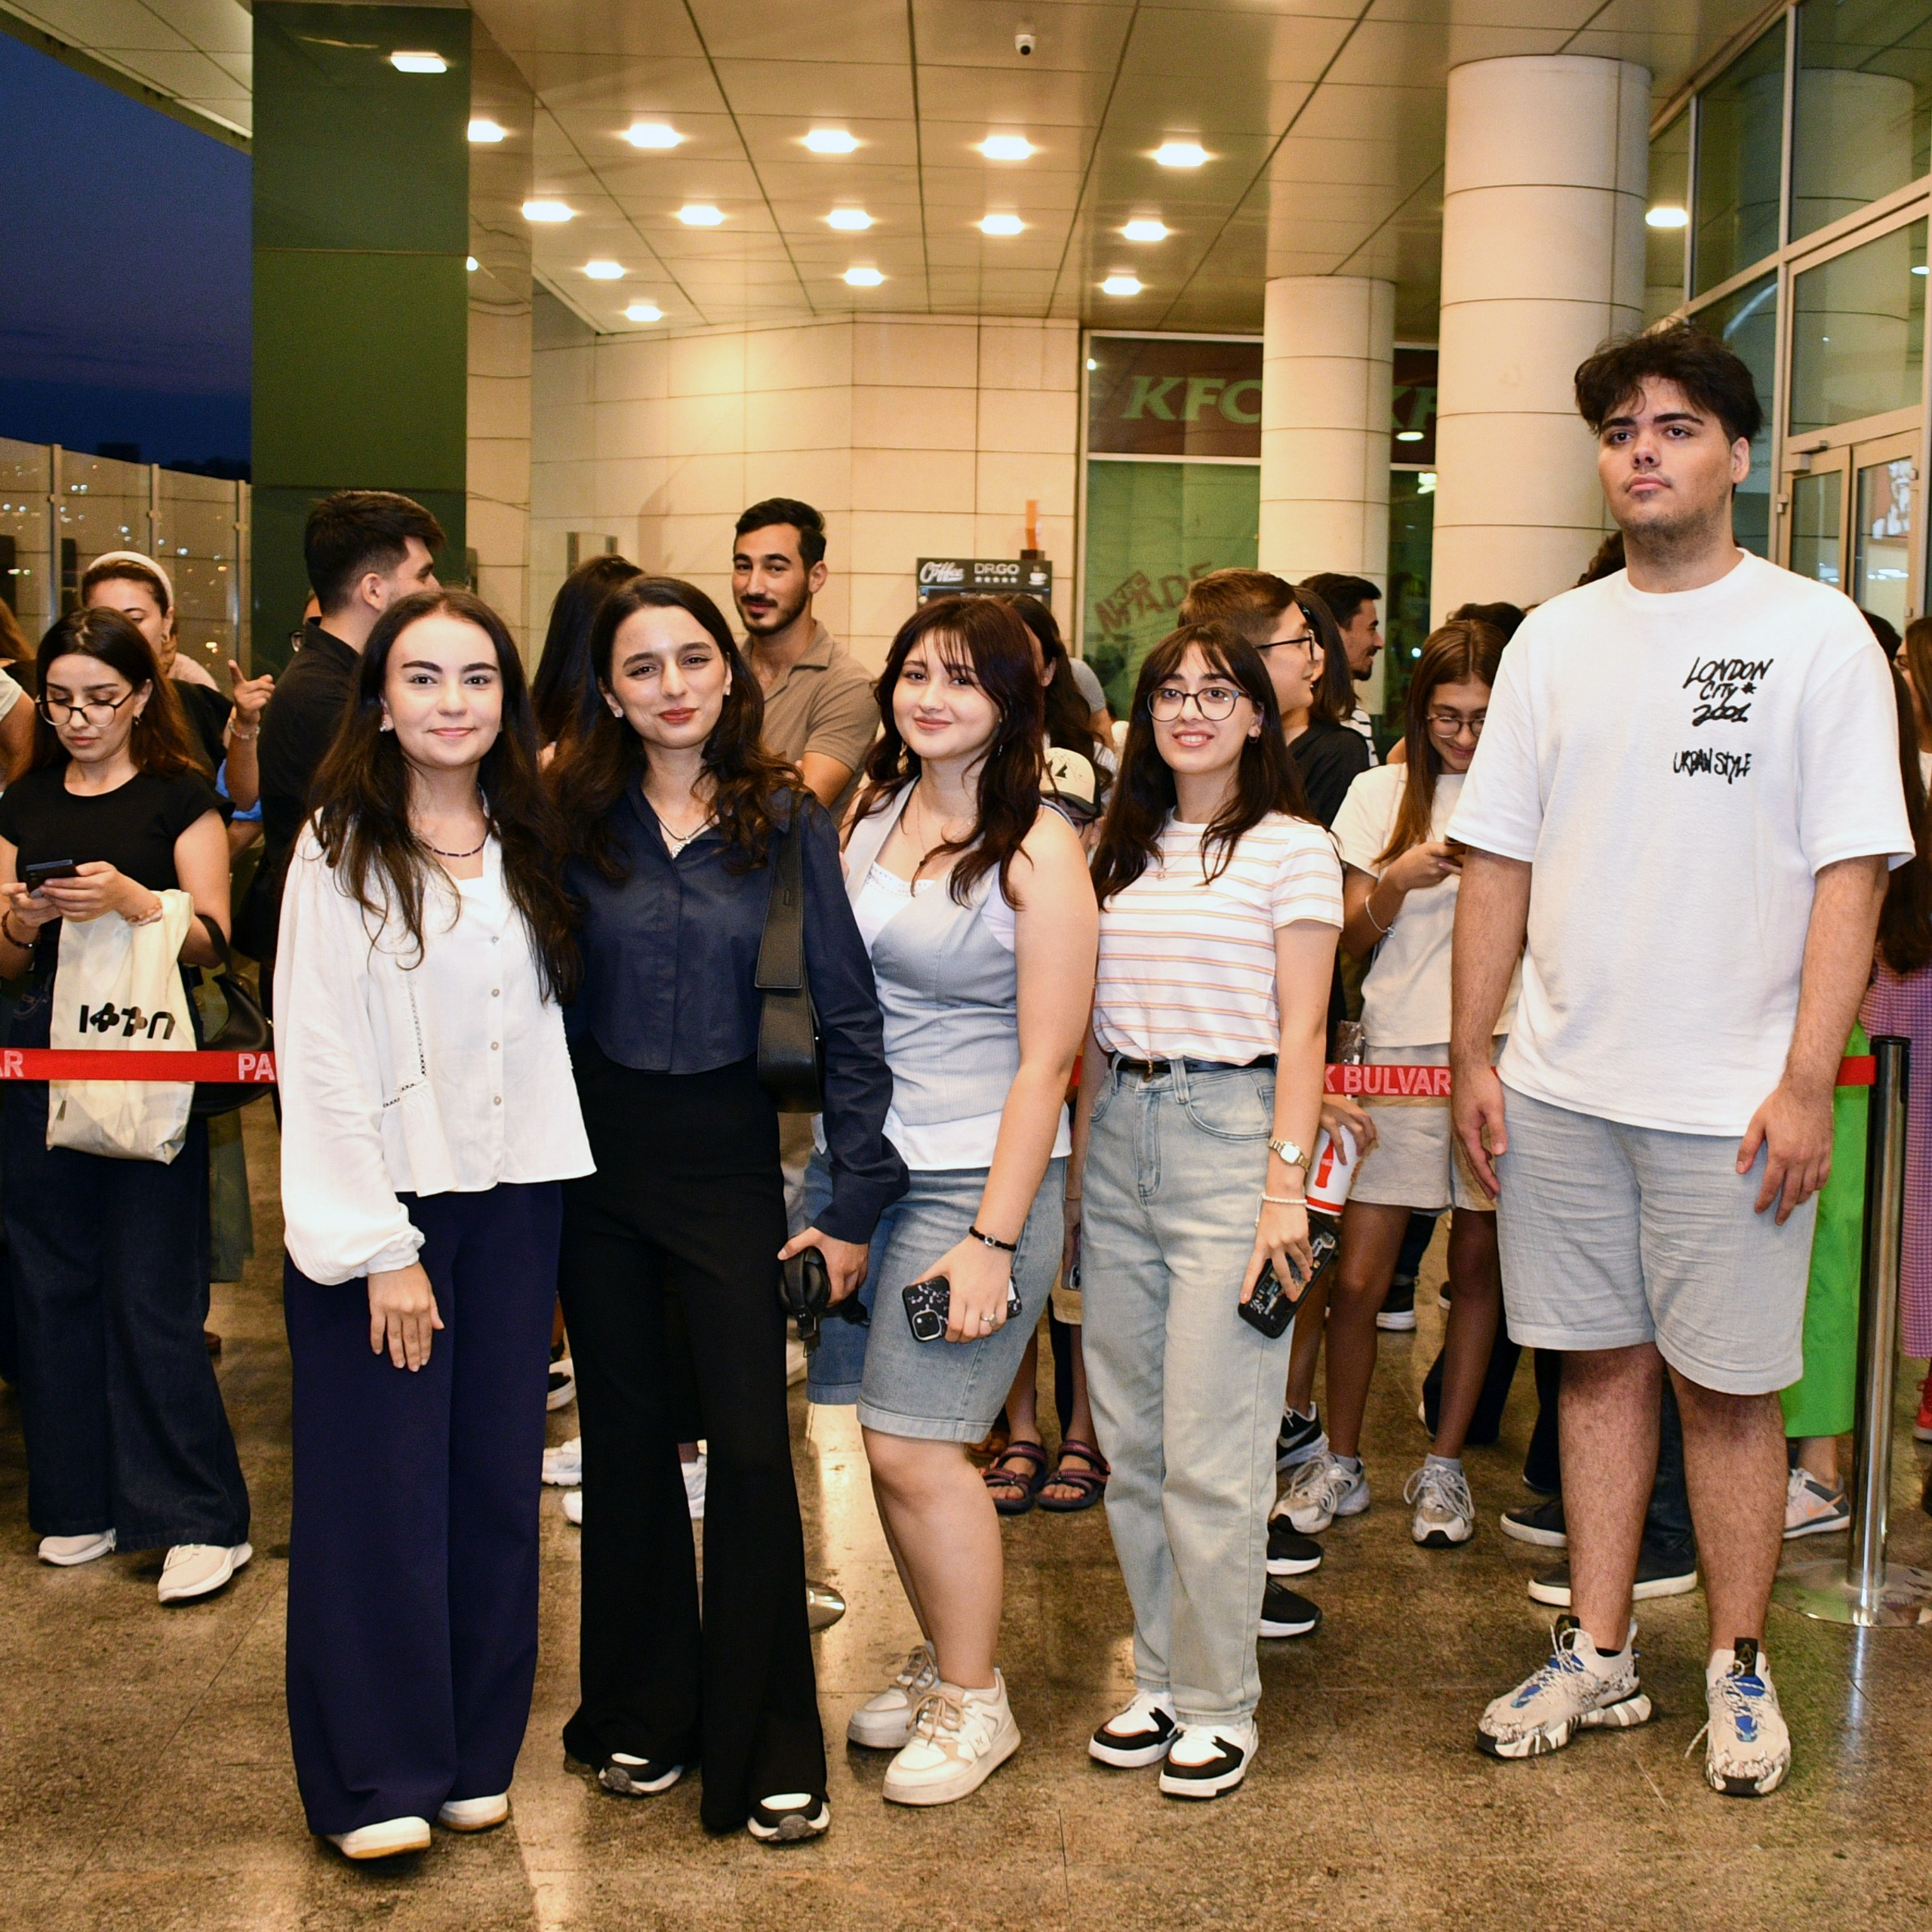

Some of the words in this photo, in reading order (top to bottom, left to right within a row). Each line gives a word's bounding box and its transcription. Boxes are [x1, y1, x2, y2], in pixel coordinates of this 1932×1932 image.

[1120, 376, 1262, 424] KFC
[920, 561, 964, 583] Coffee
[1681, 657, 1774, 689] LONDON
[1700, 681, 1739, 706] CITY
[1673, 748, 1712, 777] URBAN
[1714, 751, 1752, 785] STYLE
[1343, 1066, 1452, 1095] BULVAR
